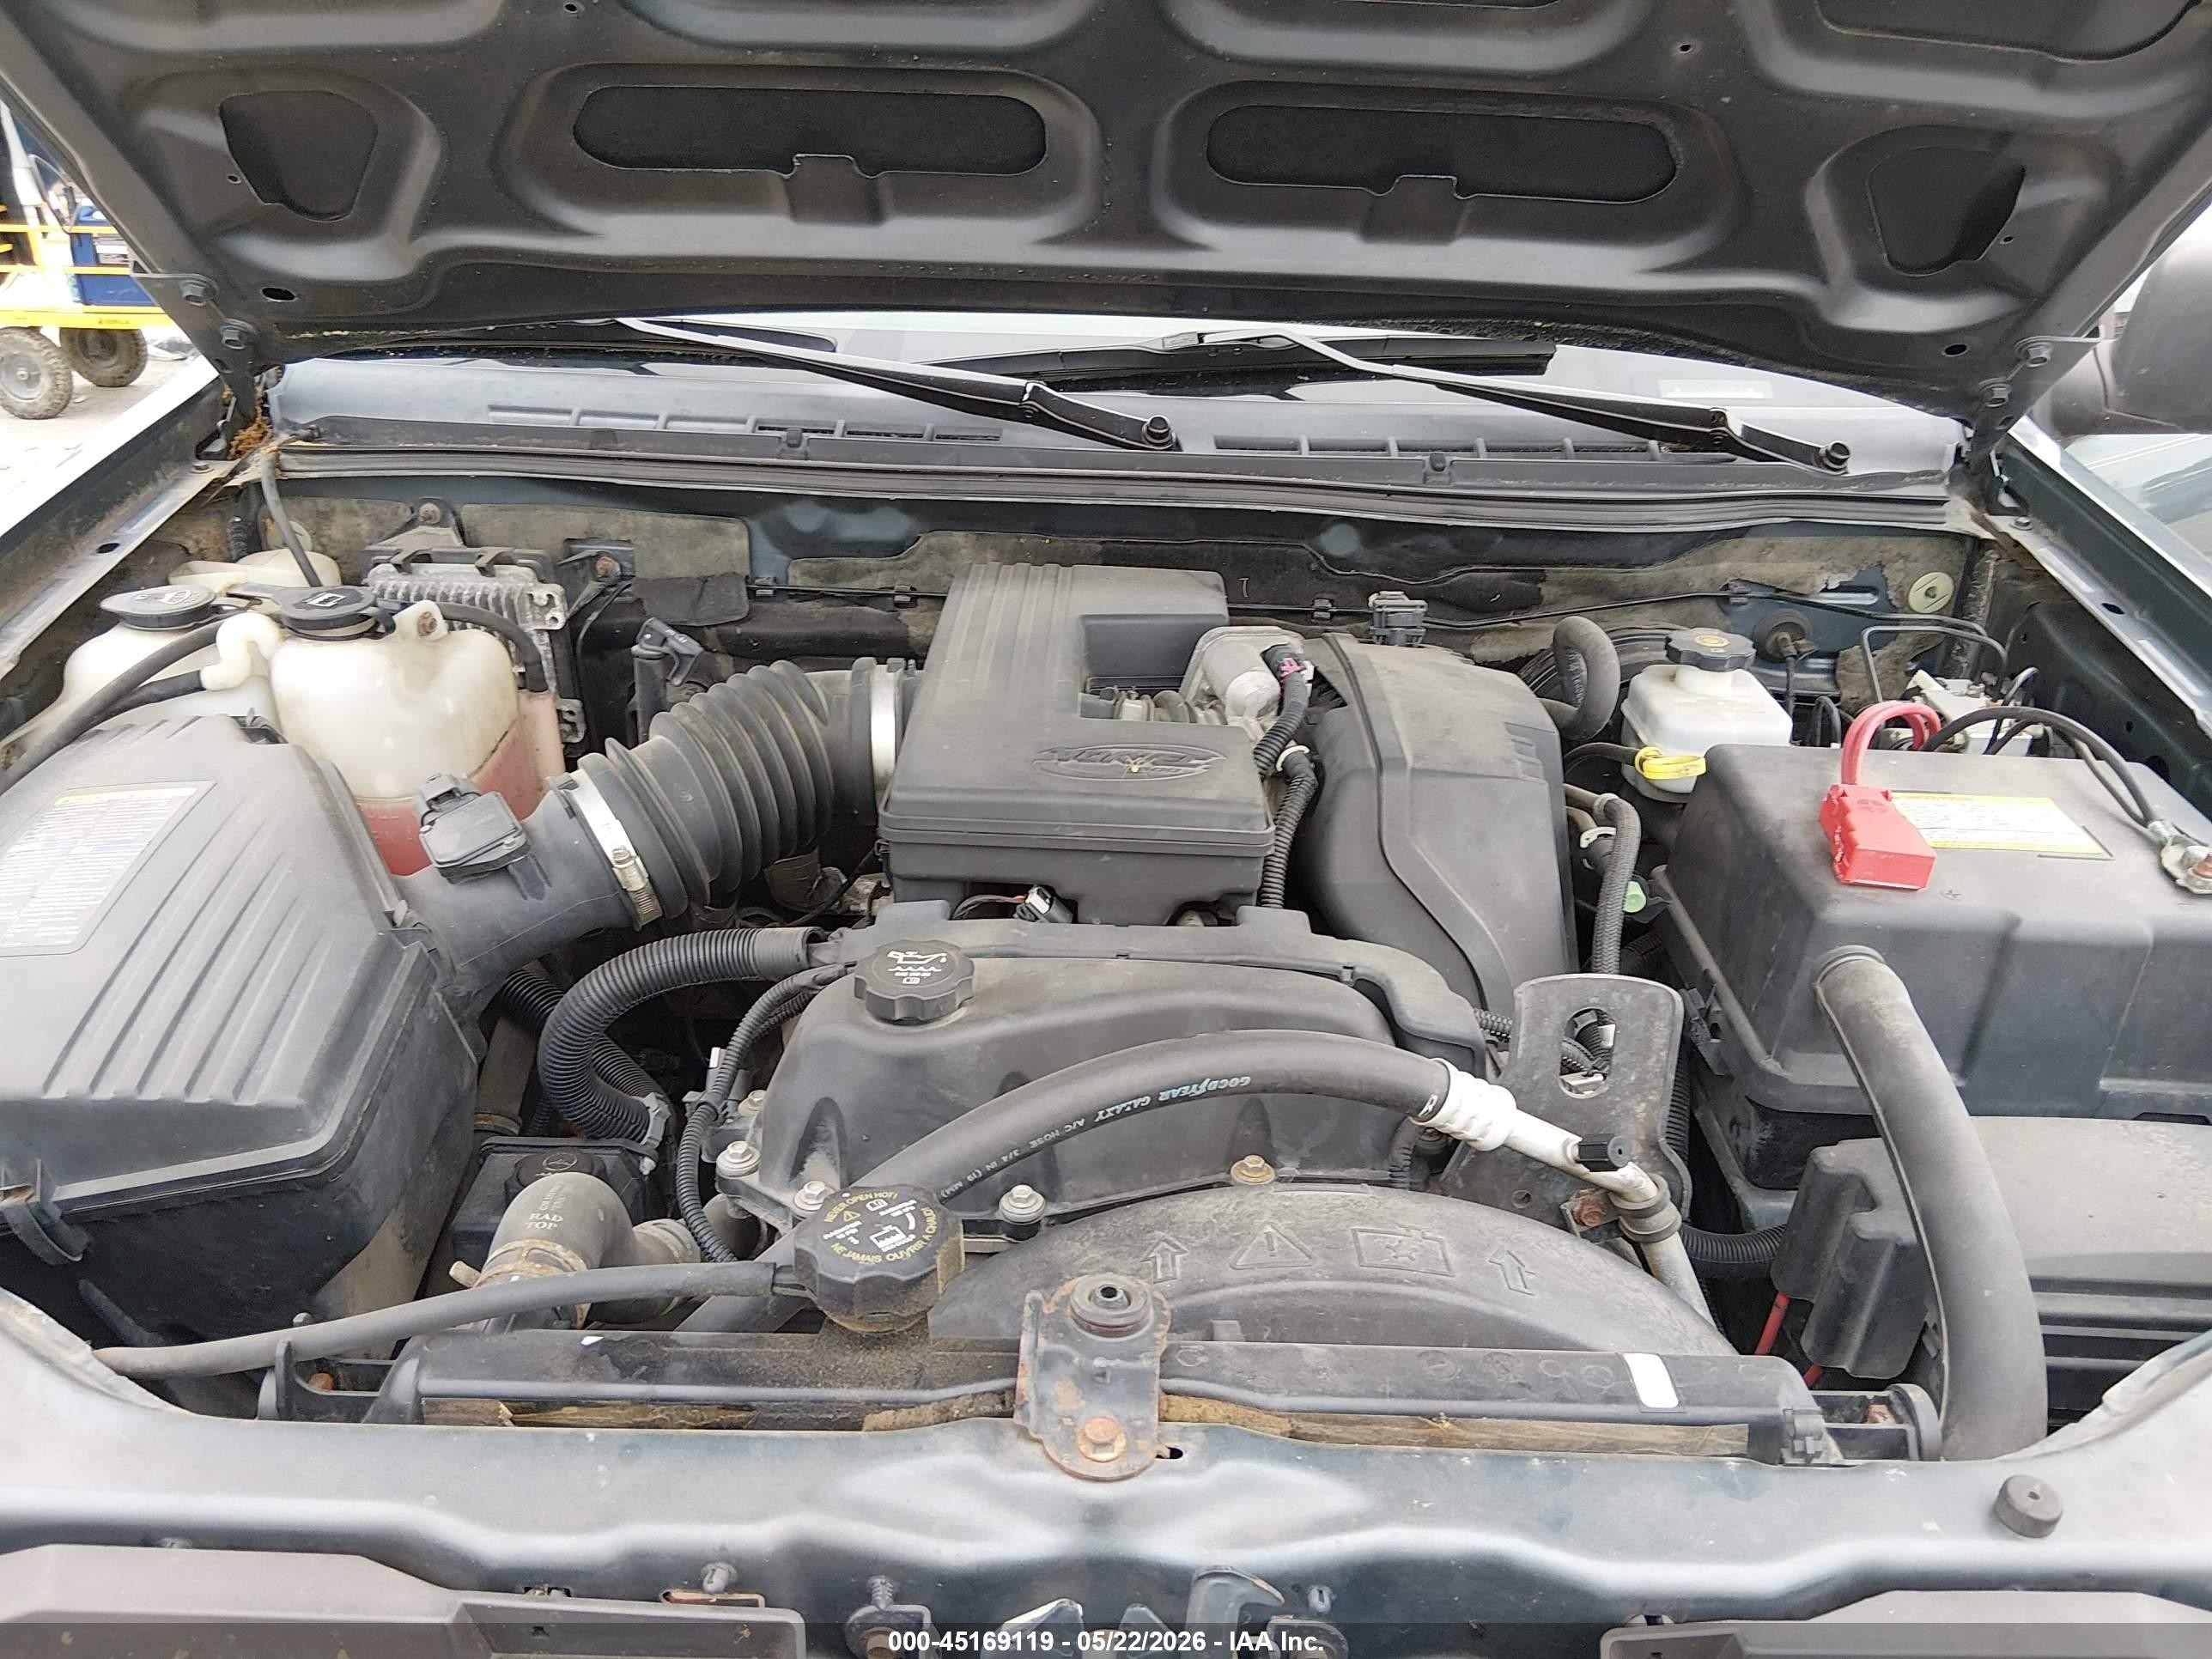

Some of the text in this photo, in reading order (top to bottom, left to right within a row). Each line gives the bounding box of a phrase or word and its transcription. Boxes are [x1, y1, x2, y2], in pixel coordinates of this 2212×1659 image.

[1063, 1117, 1086, 1133] A/C
[1028, 1129, 1060, 1149] HOSE
[823, 1191, 898, 1223] NEVER OPEN HOT!
[522, 1221, 558, 1230] TOP
[528, 1212, 564, 1222] RAD
[830, 1242, 848, 1255] NE
[842, 1251, 883, 1263] JAMAIS
[885, 1239, 928, 1261] OUVRIR
